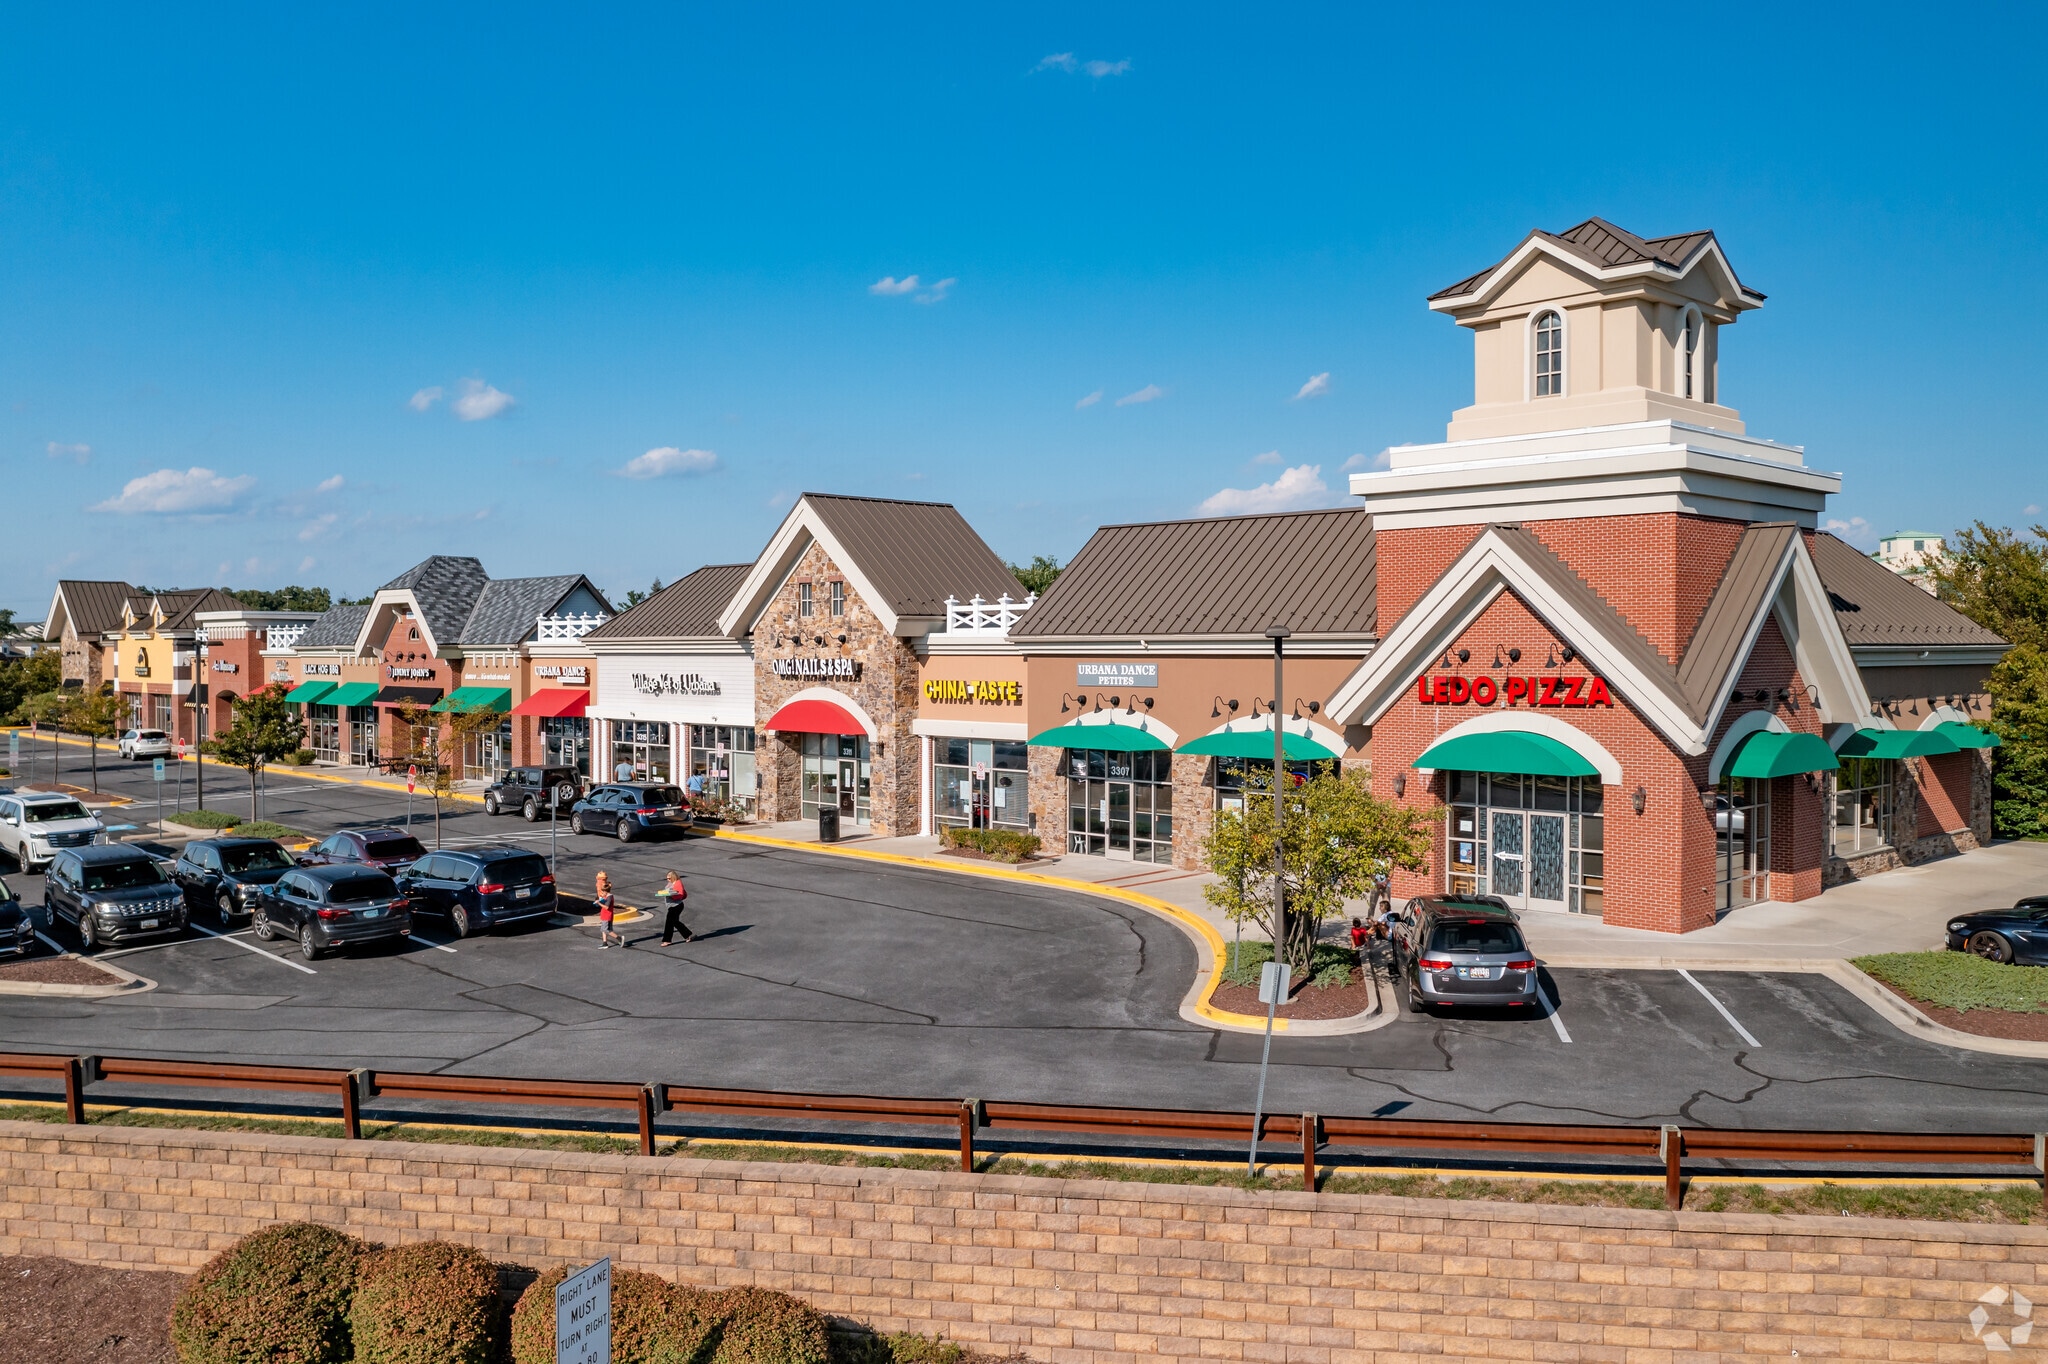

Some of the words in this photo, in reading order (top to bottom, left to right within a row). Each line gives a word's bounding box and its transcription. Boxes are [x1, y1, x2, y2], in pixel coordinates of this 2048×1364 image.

[303, 664, 317, 674] BLACK
[317, 664, 329, 674] HOG
[329, 665, 340, 674] BBQ
[392, 668, 410, 678] JIMMY
[410, 668, 430, 679] JOHN'S
[535, 666, 561, 677] URBANA
[562, 667, 587, 678] DANCE
[1078, 664, 1118, 675] URBANA
[1120, 665, 1156, 676] DANCE
[631, 673, 659, 692] Village
[684, 673, 717, 691] Urbana
[1098, 676, 1134, 686] PETITES
[923, 679, 967, 699] CHINA
[970, 681, 1017, 701] TASTE
[1418, 676, 1498, 704] LEDO
[1507, 677, 1614, 705] PIZZA
[1110, 765, 1130, 776] 3307
[560, 1284, 583, 1307] RIGHT
[587, 1269, 607, 1290] LANE
[571, 1296, 597, 1324] MUST
[561, 1330, 581, 1352] TURN
[585, 1313, 607, 1337] RIGHT
[581, 1343, 588, 1354] AT
